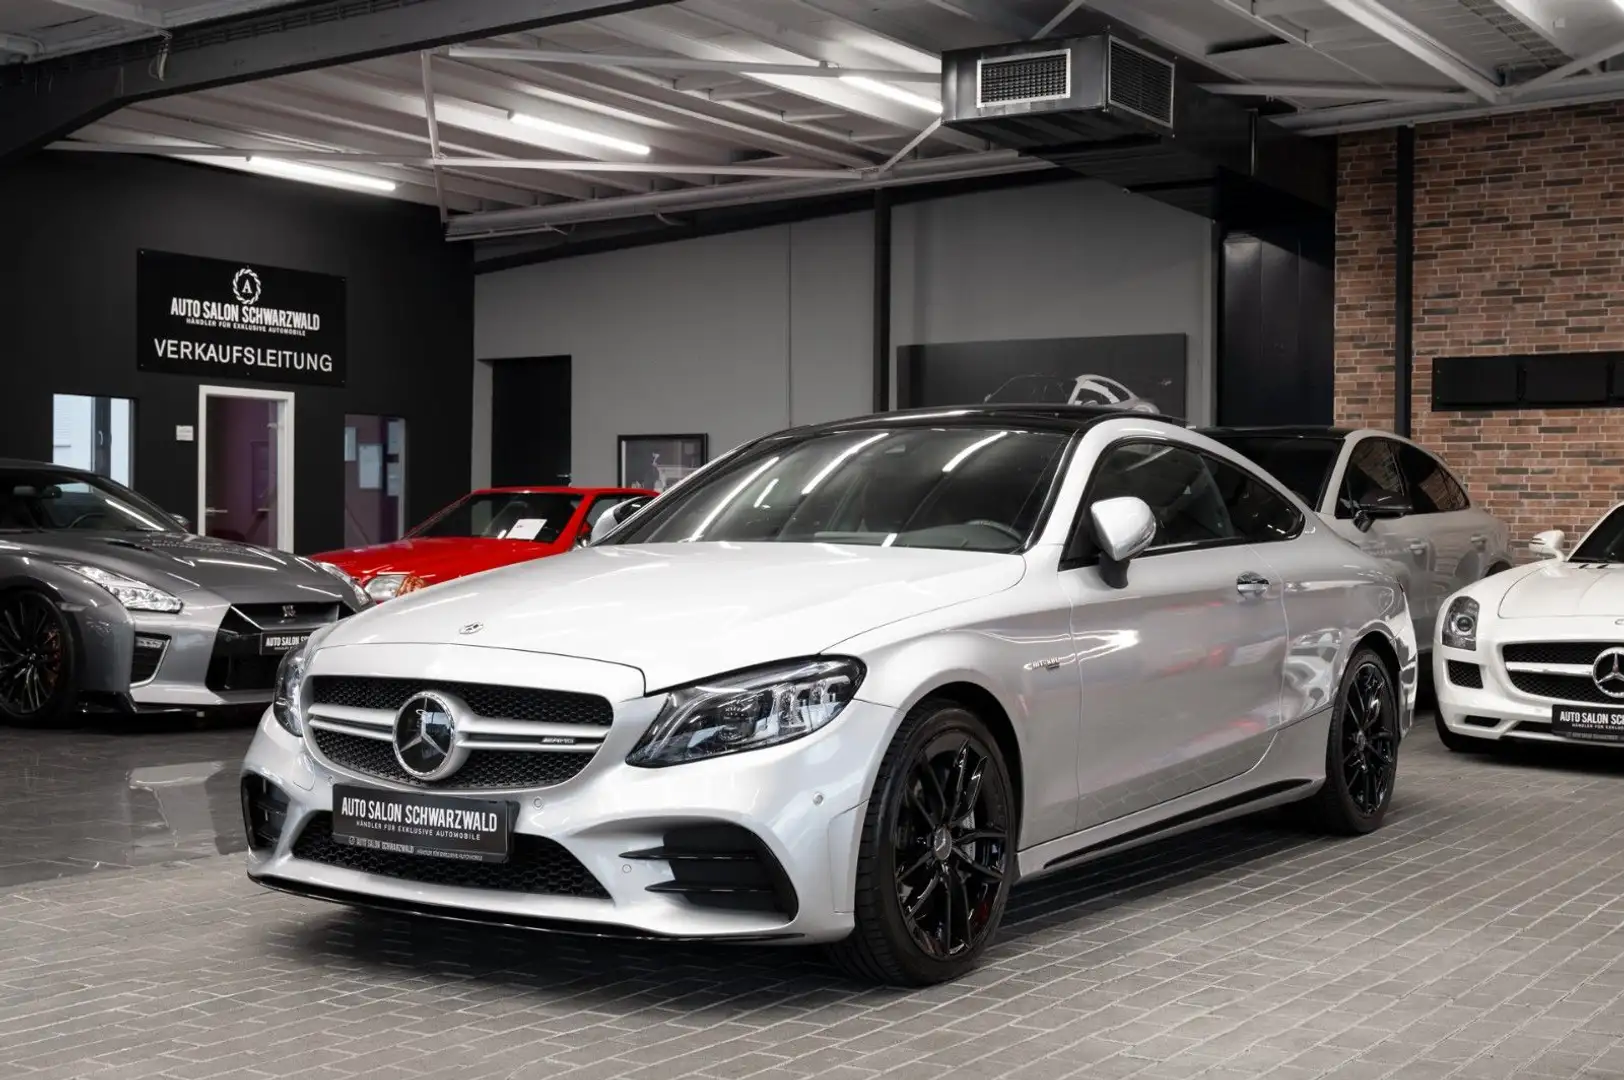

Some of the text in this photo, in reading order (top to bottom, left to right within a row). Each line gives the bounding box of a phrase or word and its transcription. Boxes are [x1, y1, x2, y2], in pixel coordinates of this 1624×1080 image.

[242, 279, 253, 294] A
[170, 297, 320, 331] AUTO SALON SCHWARZWALD
[186, 317, 306, 337] HÄNDLER FÜR EXKLUSIVE AUTOMOBILE
[154, 338, 333, 372] VERKAUFSLEITUNG
[265, 637, 281, 647] AUTO
[281, 636, 300, 646] SALON
[1560, 711, 1580, 723] AUTO
[1581, 712, 1609, 724] SALON
[341, 797, 498, 832] AUTO SALON SCHWARZWALD
[356, 820, 481, 841] HÄNDLER FÜR EXKLUSIVE AUTOMOBILE
